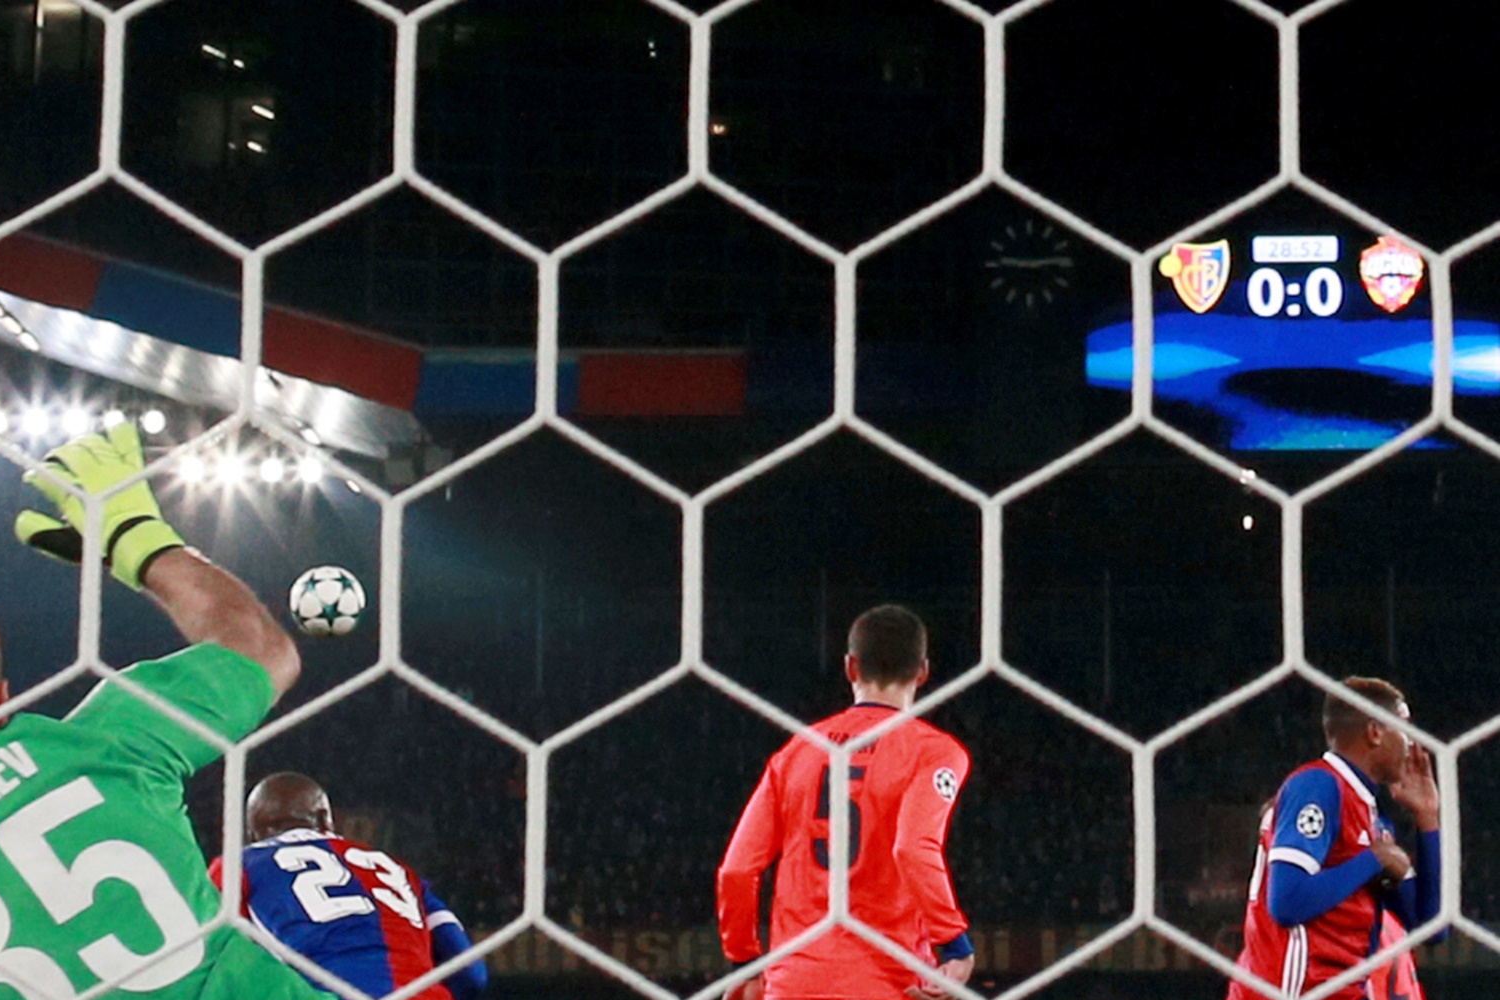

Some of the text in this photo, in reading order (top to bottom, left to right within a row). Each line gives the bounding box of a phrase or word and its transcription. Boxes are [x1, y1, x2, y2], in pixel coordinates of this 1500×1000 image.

[1268, 240, 1324, 259] 28:52
[1247, 267, 1343, 317] 0:0
[813, 765, 864, 871] 5
[273, 844, 425, 930] 23
